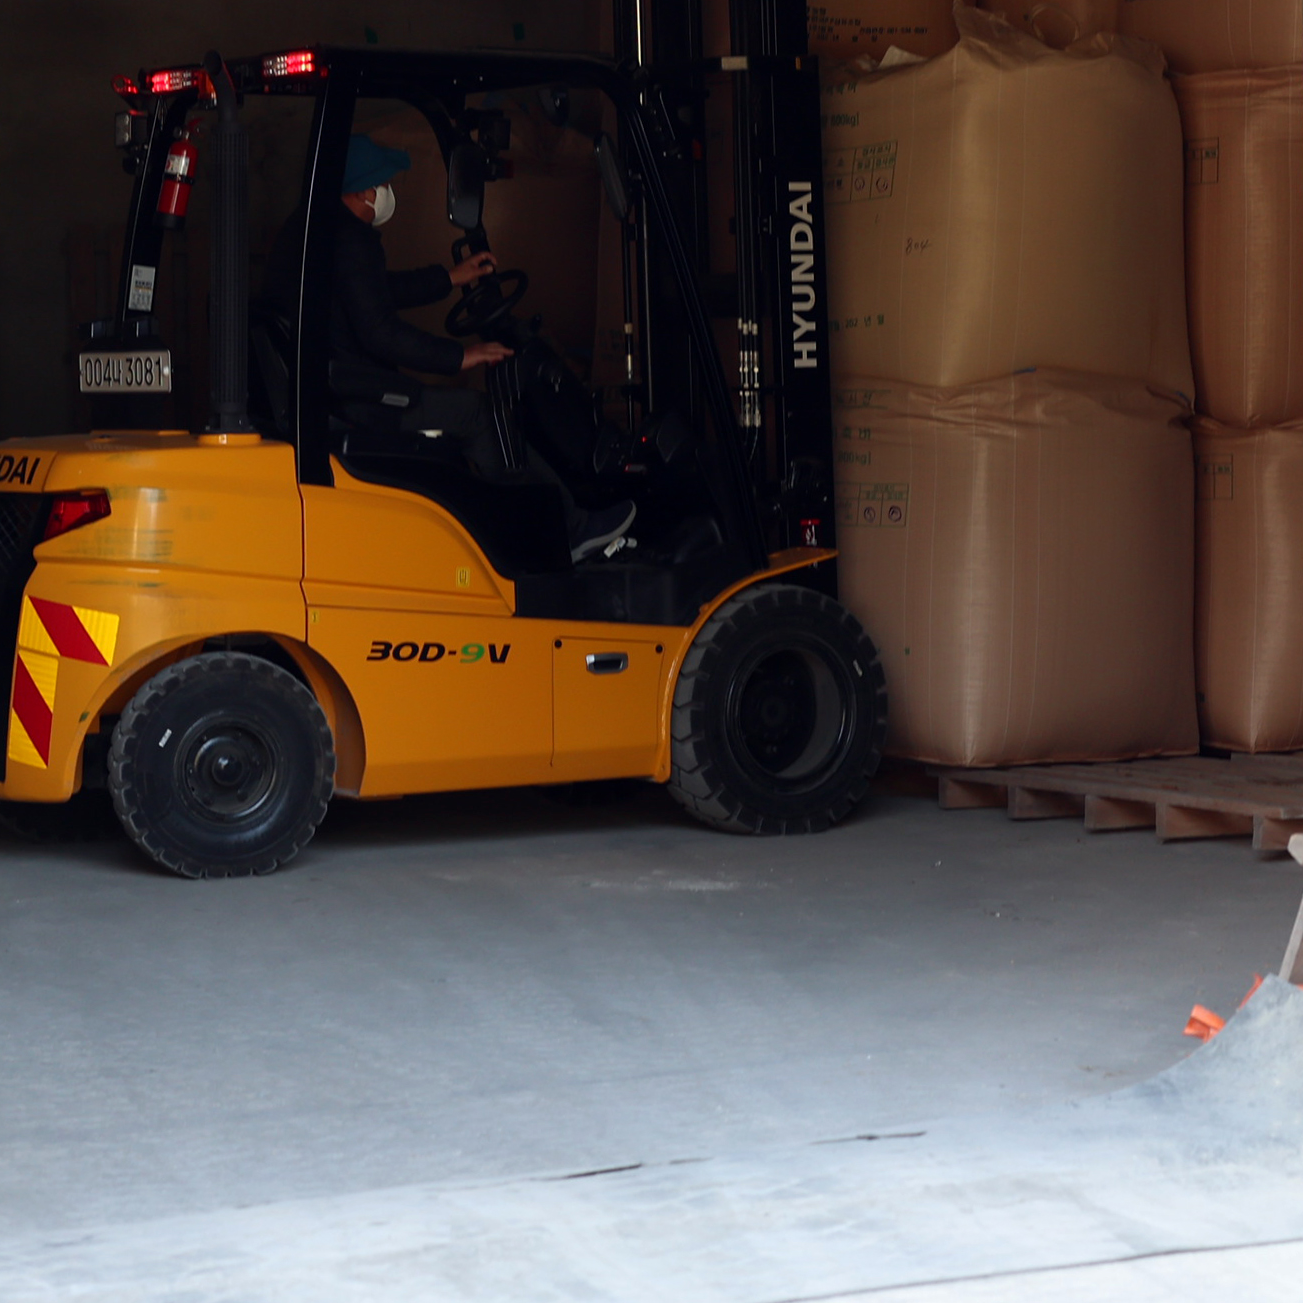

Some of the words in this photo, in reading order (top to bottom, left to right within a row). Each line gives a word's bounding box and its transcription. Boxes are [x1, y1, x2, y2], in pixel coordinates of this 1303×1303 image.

[788, 180, 818, 369] HYUNDAI
[126, 356, 162, 386] 3081
[366, 641, 511, 664] 30D-9V
